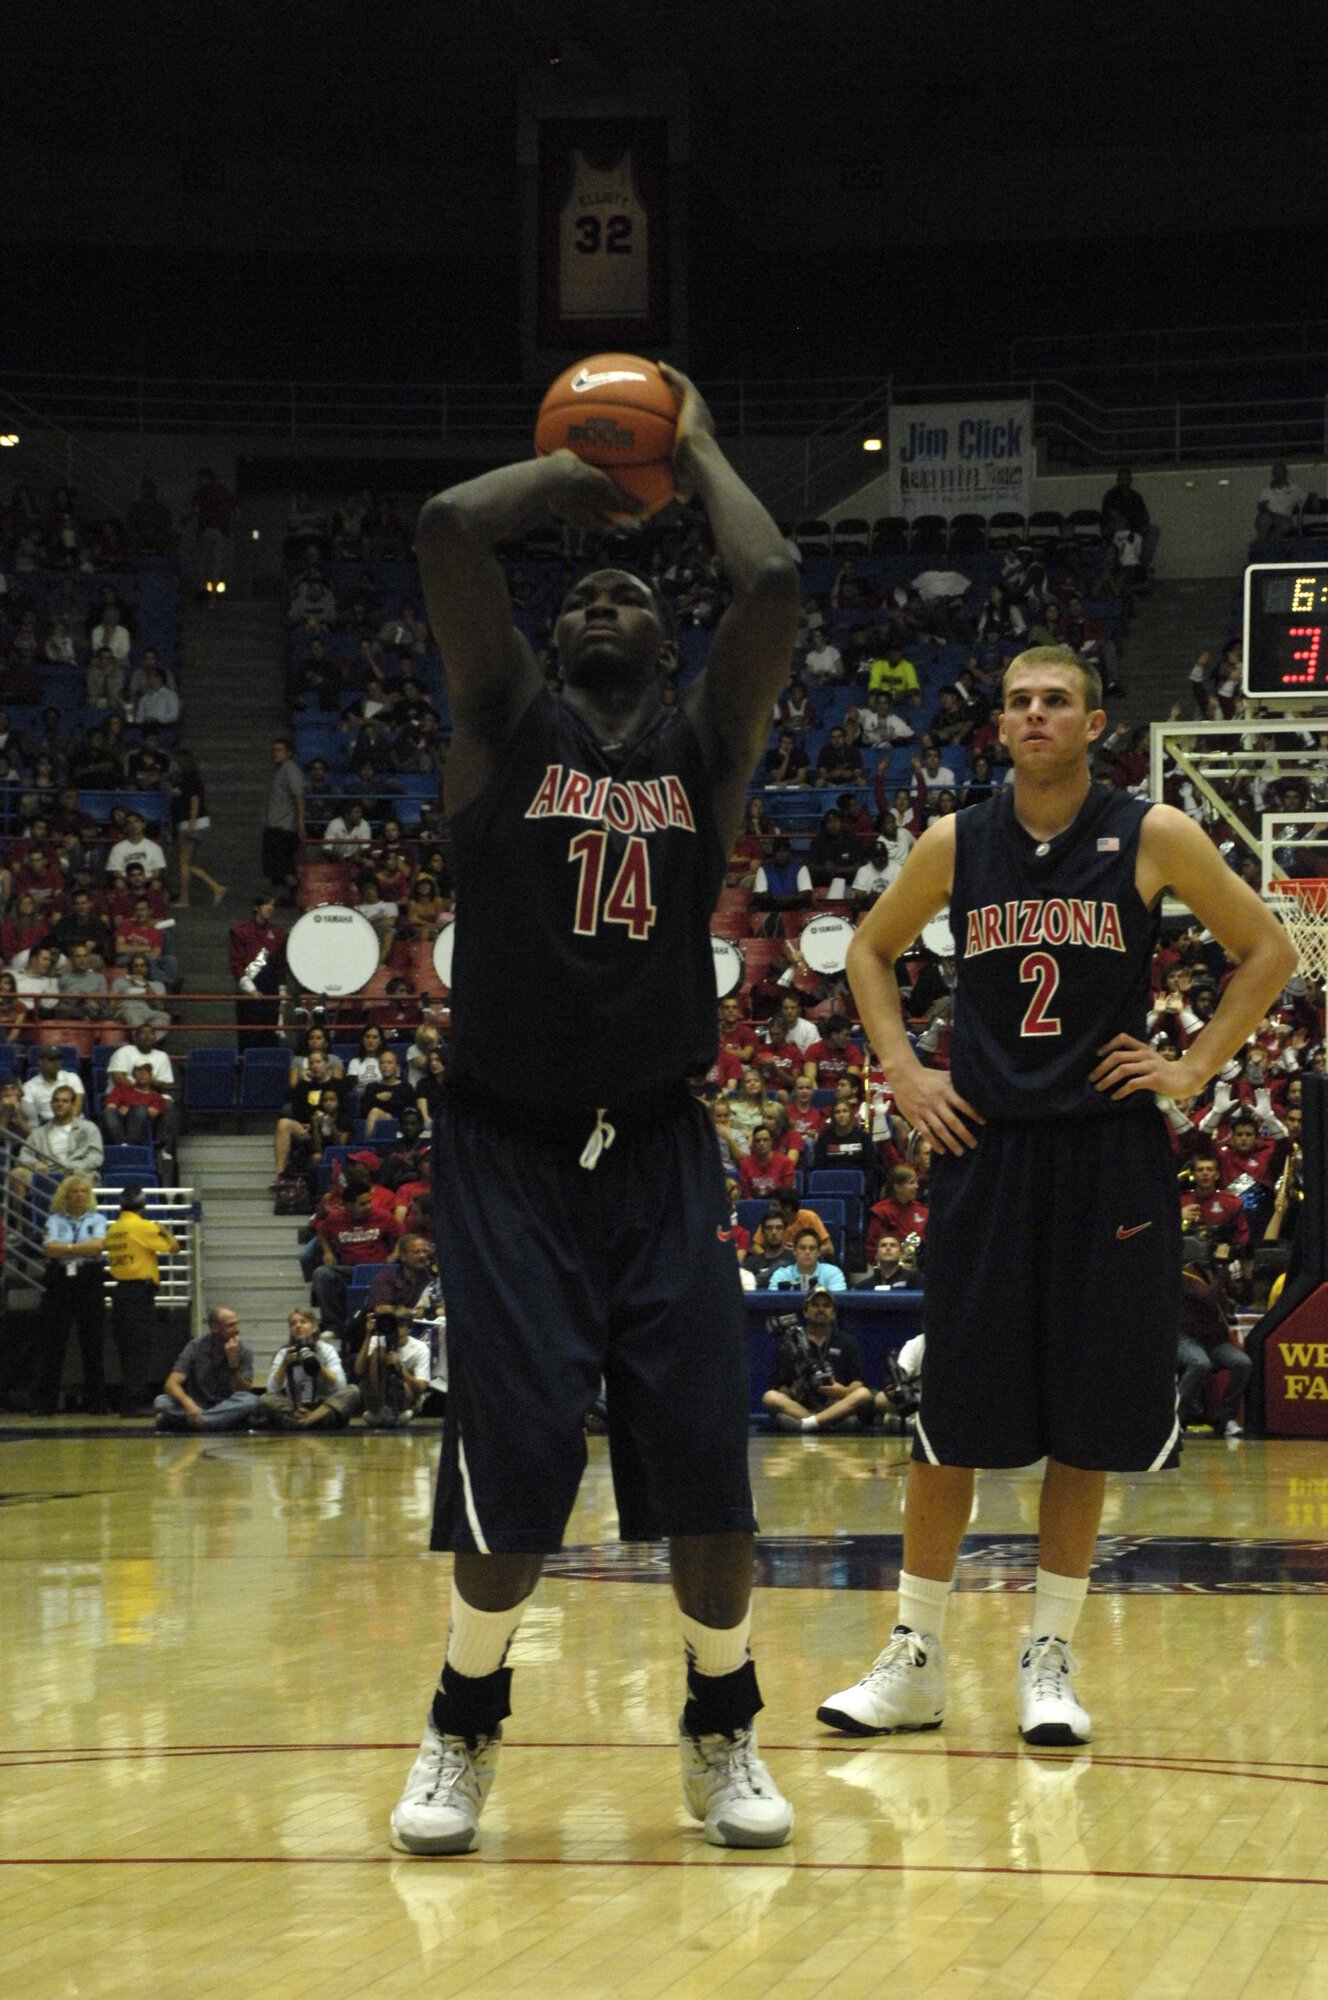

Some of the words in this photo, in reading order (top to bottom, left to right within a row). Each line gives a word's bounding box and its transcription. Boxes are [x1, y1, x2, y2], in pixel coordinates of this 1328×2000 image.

[574, 214, 633, 255] 32
[900, 421, 948, 463] Jim
[958, 417, 1023, 461] Click
[524, 764, 697, 834] ARIONA
[567, 828, 658, 942] 14
[323, 915, 353, 923] YAMAHA
[819, 924, 843, 933] YAMAHA
[963, 898, 1127, 959] ARIZONA
[1019, 951, 1062, 1038] 2
[1283, 1374, 1328, 1400] FA
